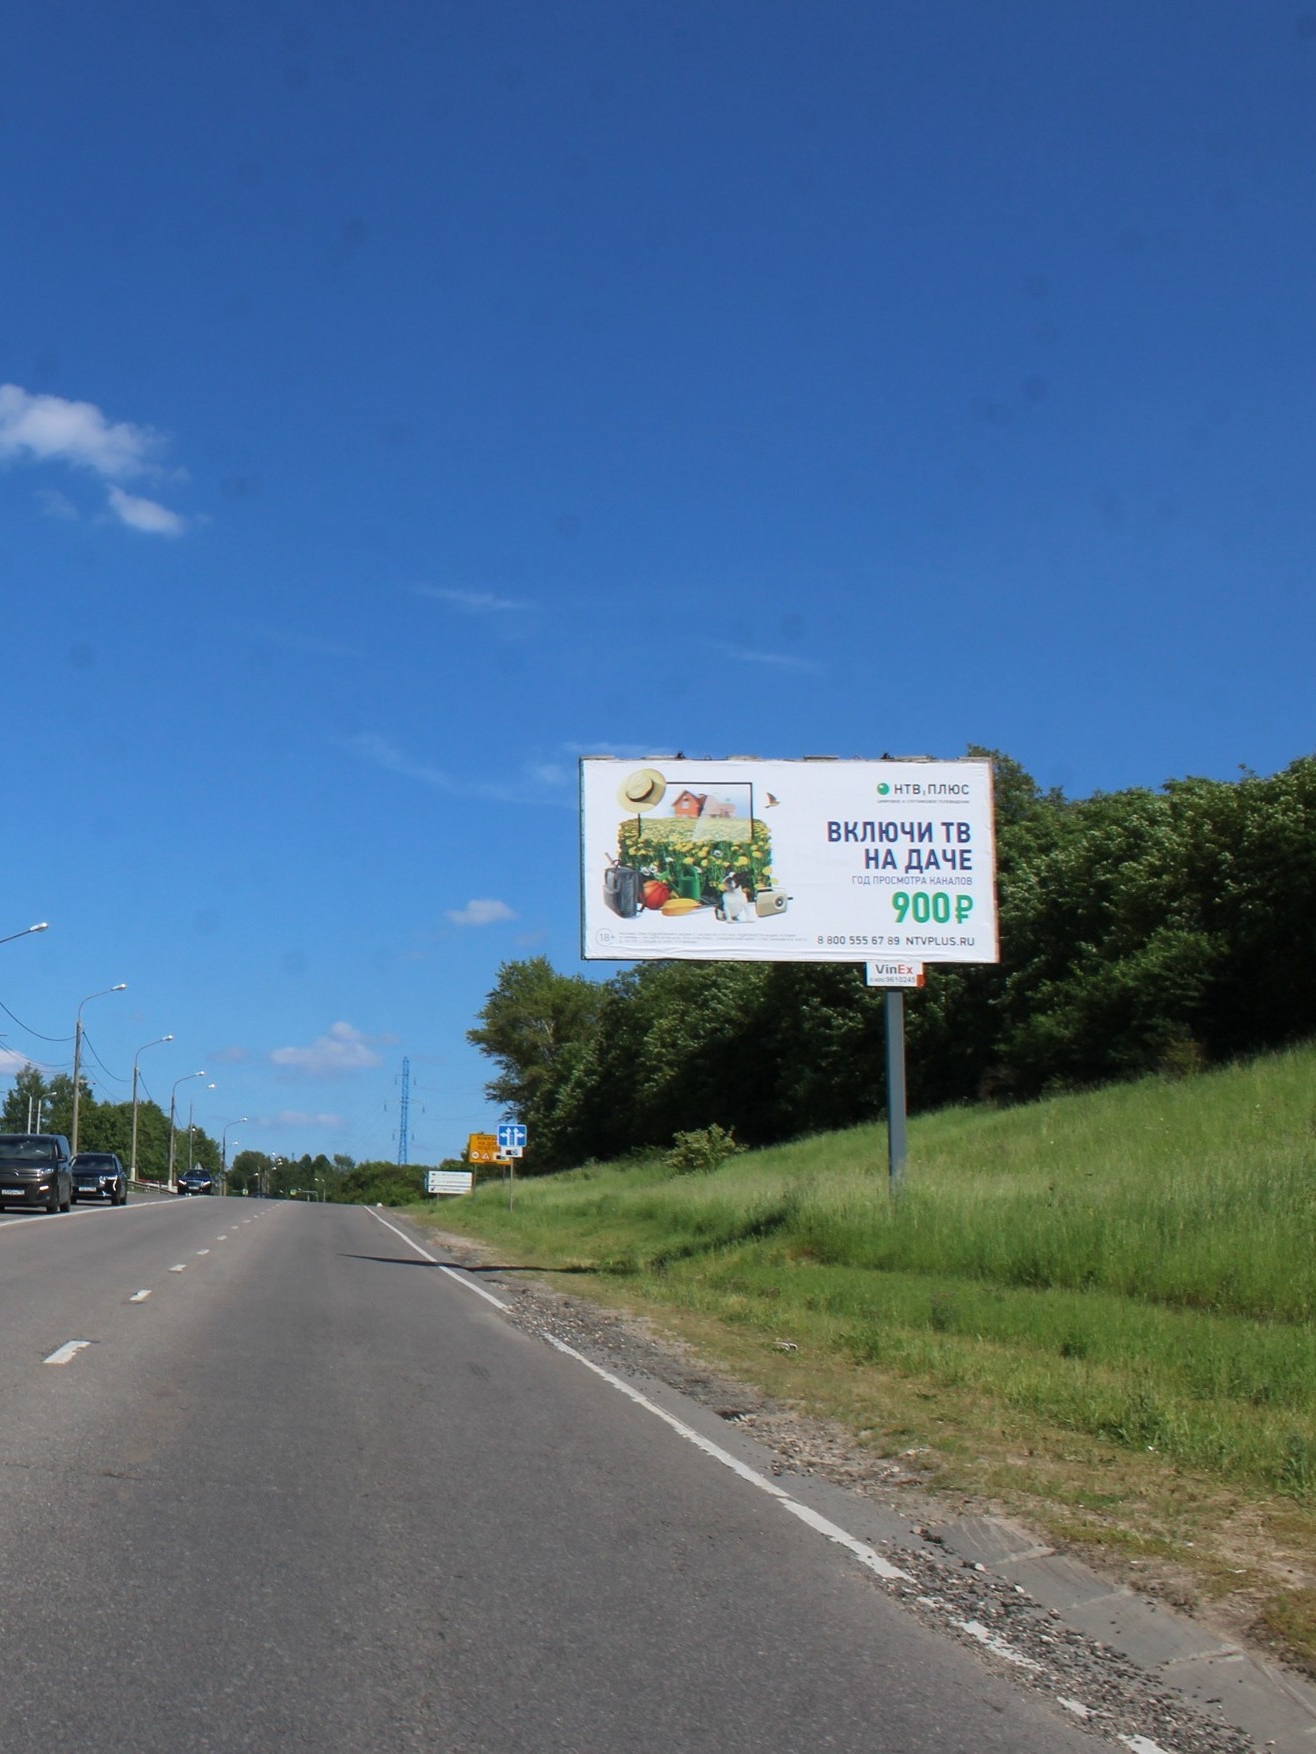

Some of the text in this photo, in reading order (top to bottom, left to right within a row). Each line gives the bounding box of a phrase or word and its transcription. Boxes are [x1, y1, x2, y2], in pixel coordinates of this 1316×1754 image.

[894, 784, 969, 795] НТВ ПЛЮС
[827, 821, 971, 843] ВКЛЮЧИ ТВ
[864, 848, 972, 874] НА ДАЧЕ
[852, 876, 973, 886] ГОД ПРОСМОТРА КАНАЛОВ
[817, 936, 824, 945] 8
[827, 936, 846, 945] 800
[849, 936, 868, 945] 555
[871, 936, 884, 945] 67
[888, 936, 900, 946] 89
[905, 936, 975, 947] NTVPLUS.RU
[875, 964, 913, 974] VinEx
